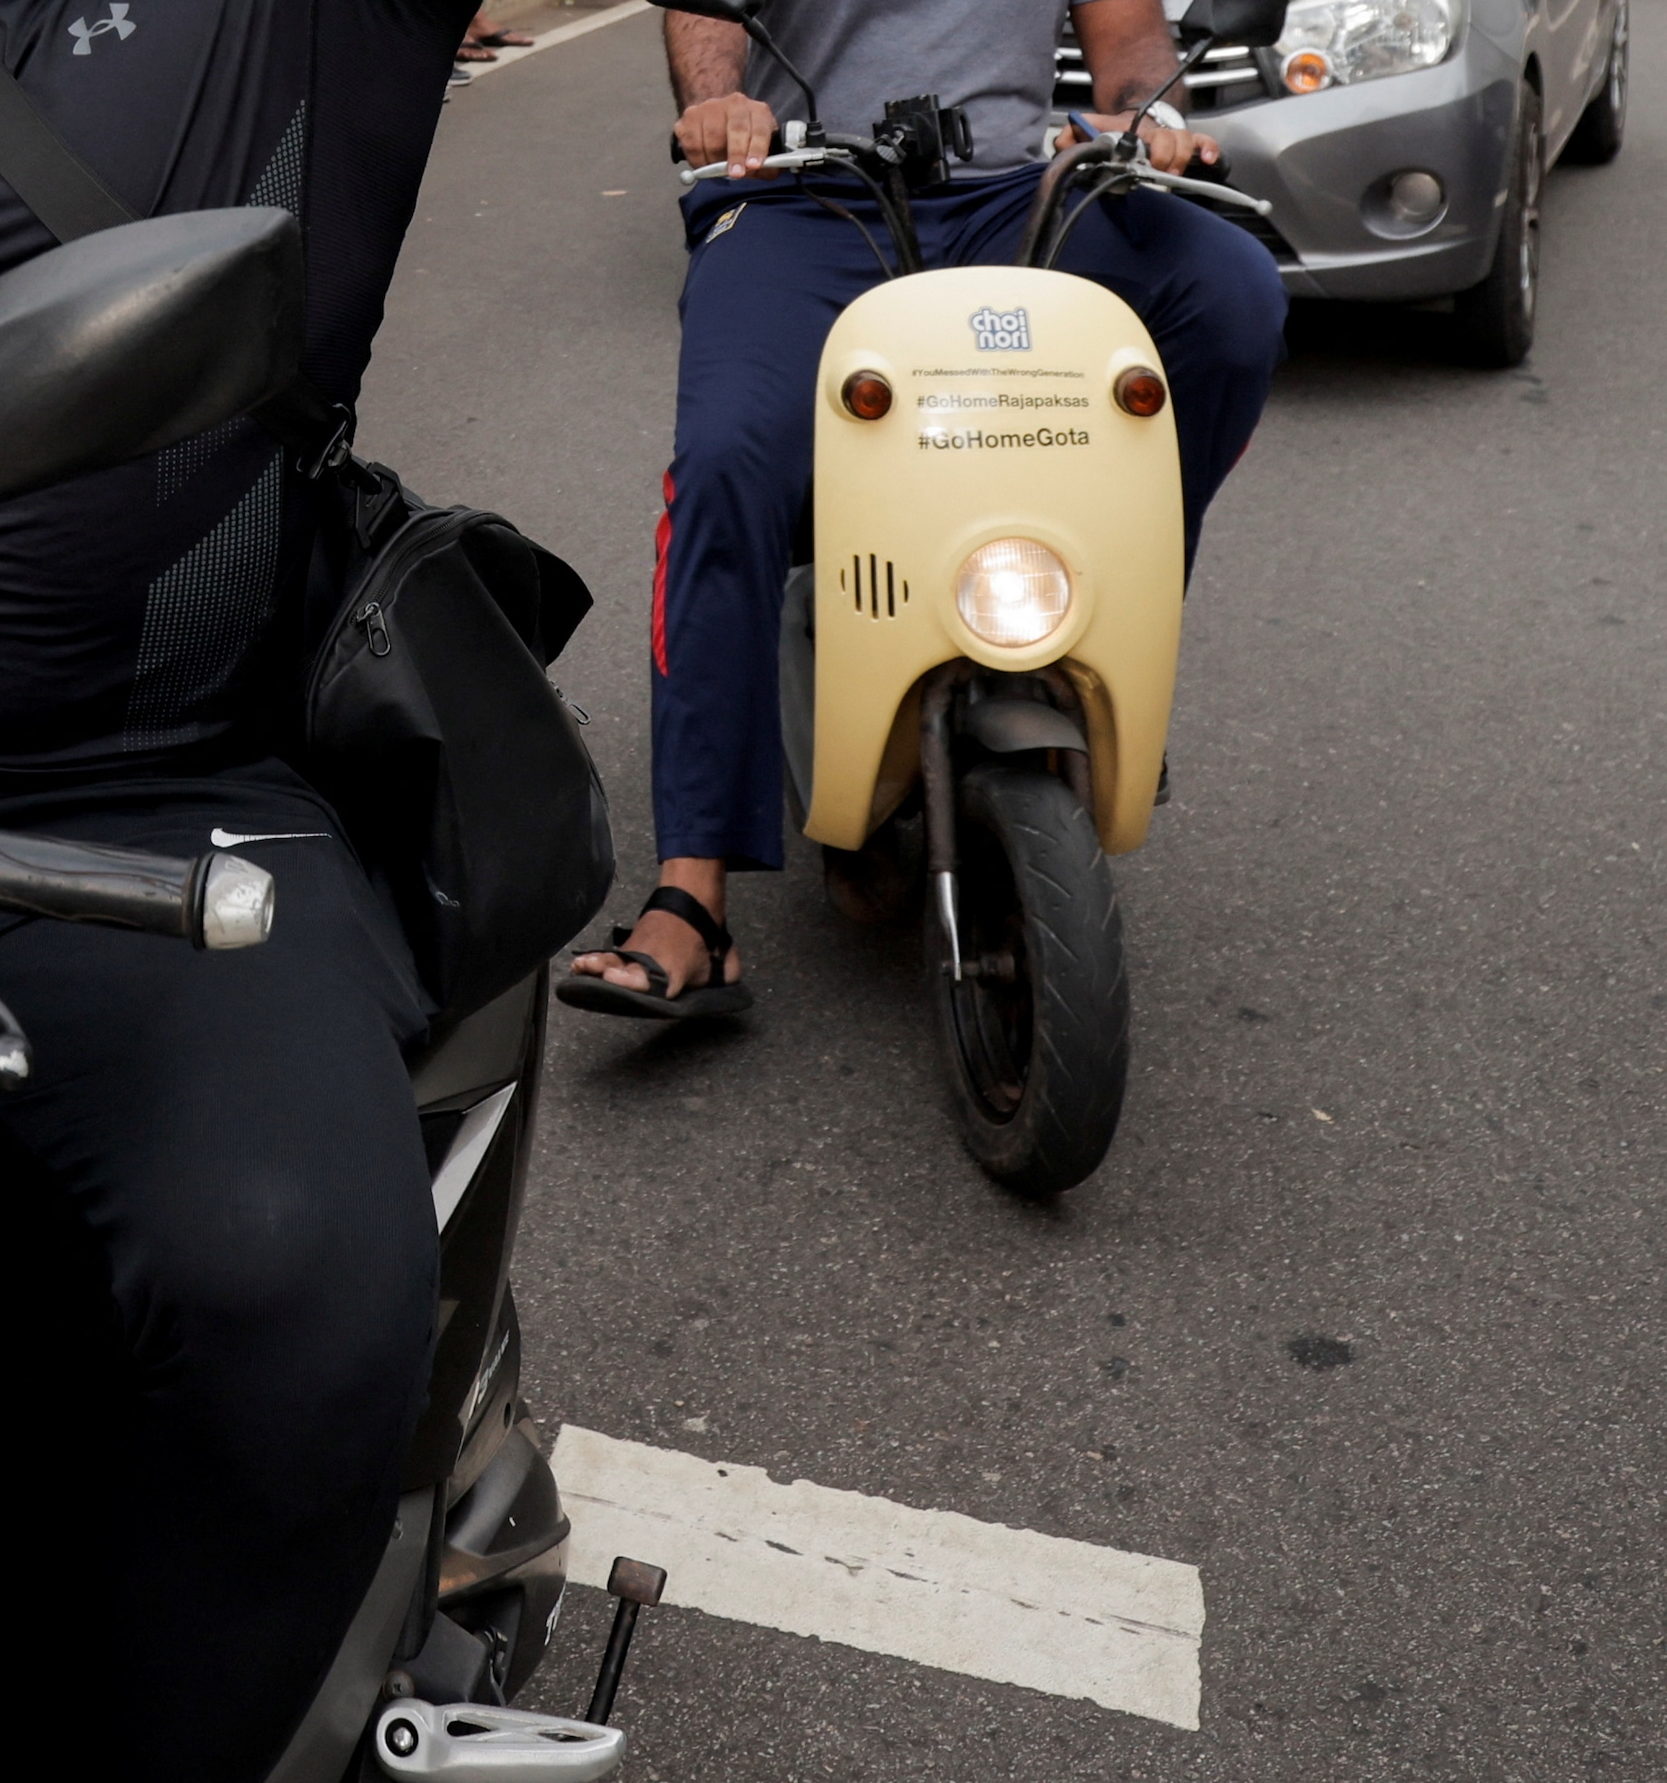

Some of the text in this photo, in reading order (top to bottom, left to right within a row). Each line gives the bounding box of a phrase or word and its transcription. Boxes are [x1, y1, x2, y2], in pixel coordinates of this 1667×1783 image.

[971, 308, 1027, 332] choi
[978, 326, 1030, 350] nori
[912, 367, 1085, 379] #YouMessedWithTheWrongGeneration
[916, 394, 1089, 410] #GoHomeRajapaksas
[918, 427, 1090, 450] #GoHomeGota
